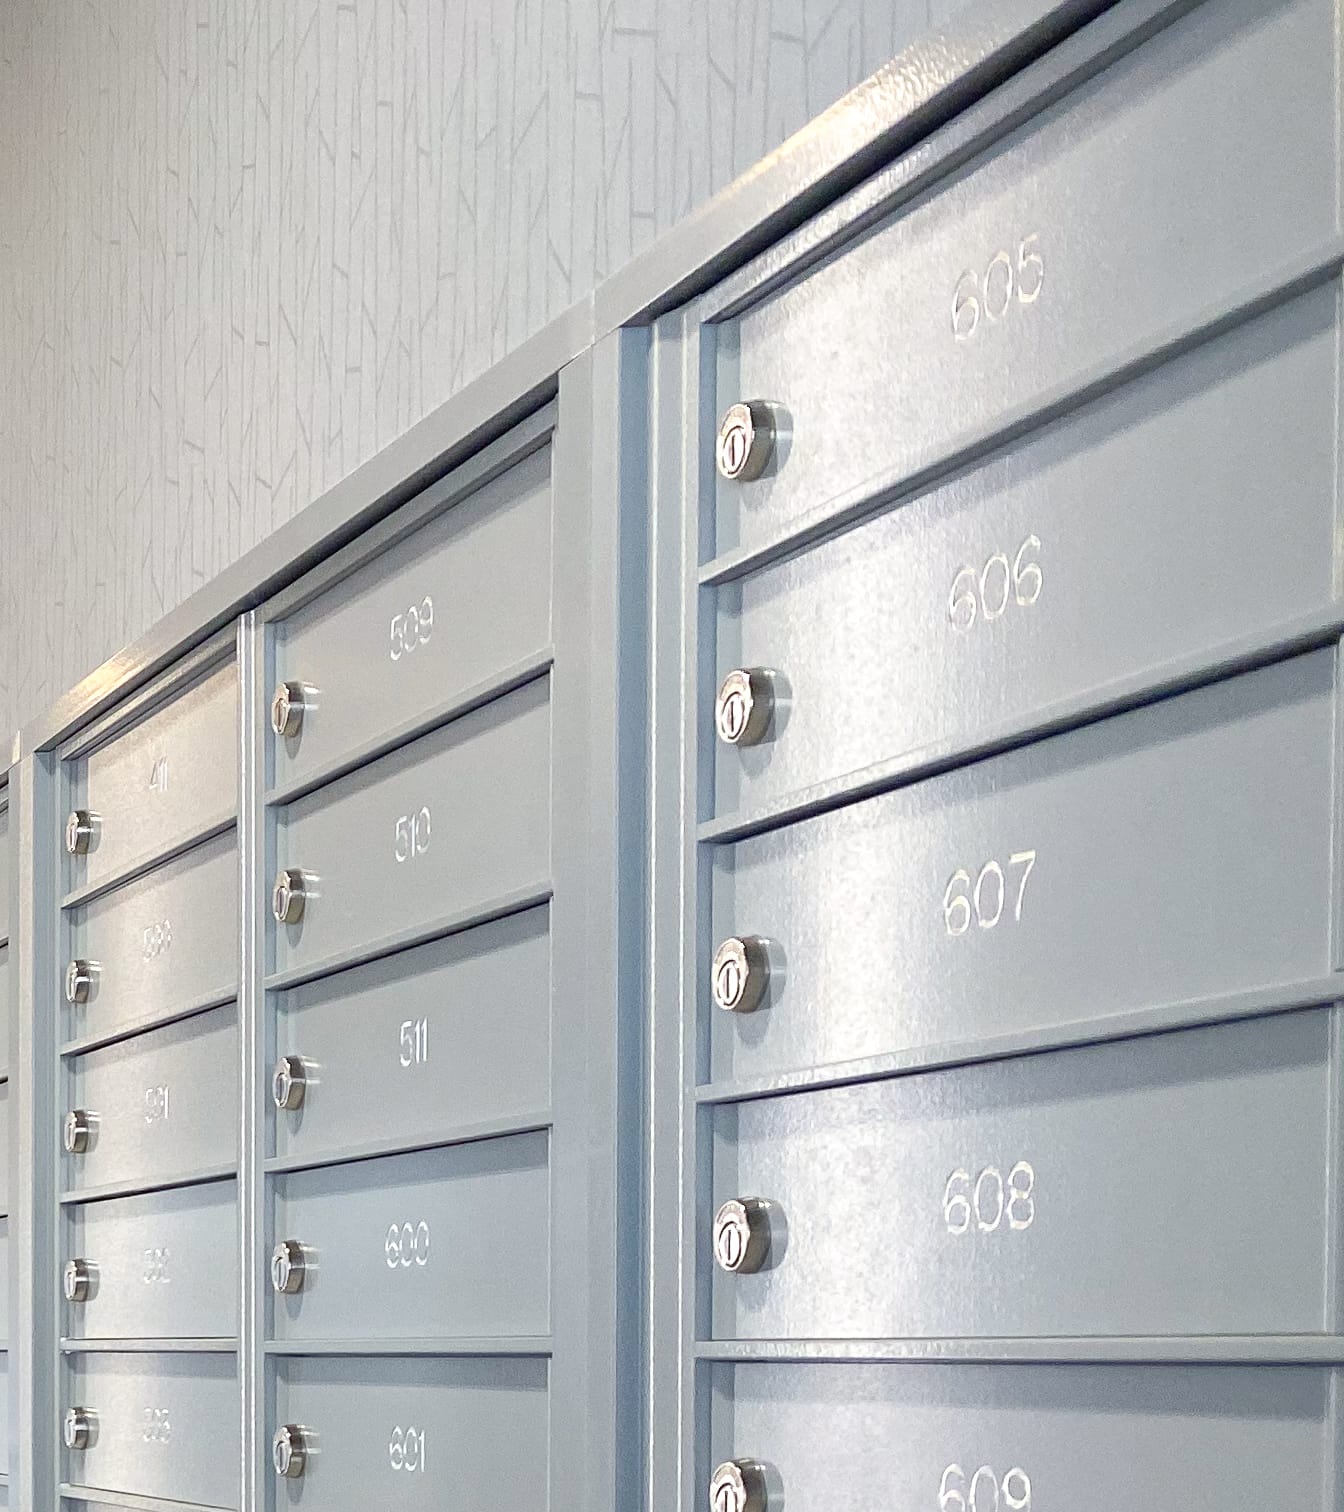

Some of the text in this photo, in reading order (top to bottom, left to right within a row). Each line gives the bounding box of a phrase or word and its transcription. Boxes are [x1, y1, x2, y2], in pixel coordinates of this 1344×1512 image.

[952, 233, 1045, 341] 605
[947, 534, 1045, 631] 606
[390, 596, 433, 660] 509
[394, 806, 431, 862] 510
[942, 850, 1037, 938] 607
[399, 1017, 428, 1066] 511
[942, 1159, 1036, 1237] 608
[385, 1220, 430, 1268] 600
[389, 1426, 425, 1473] 601
